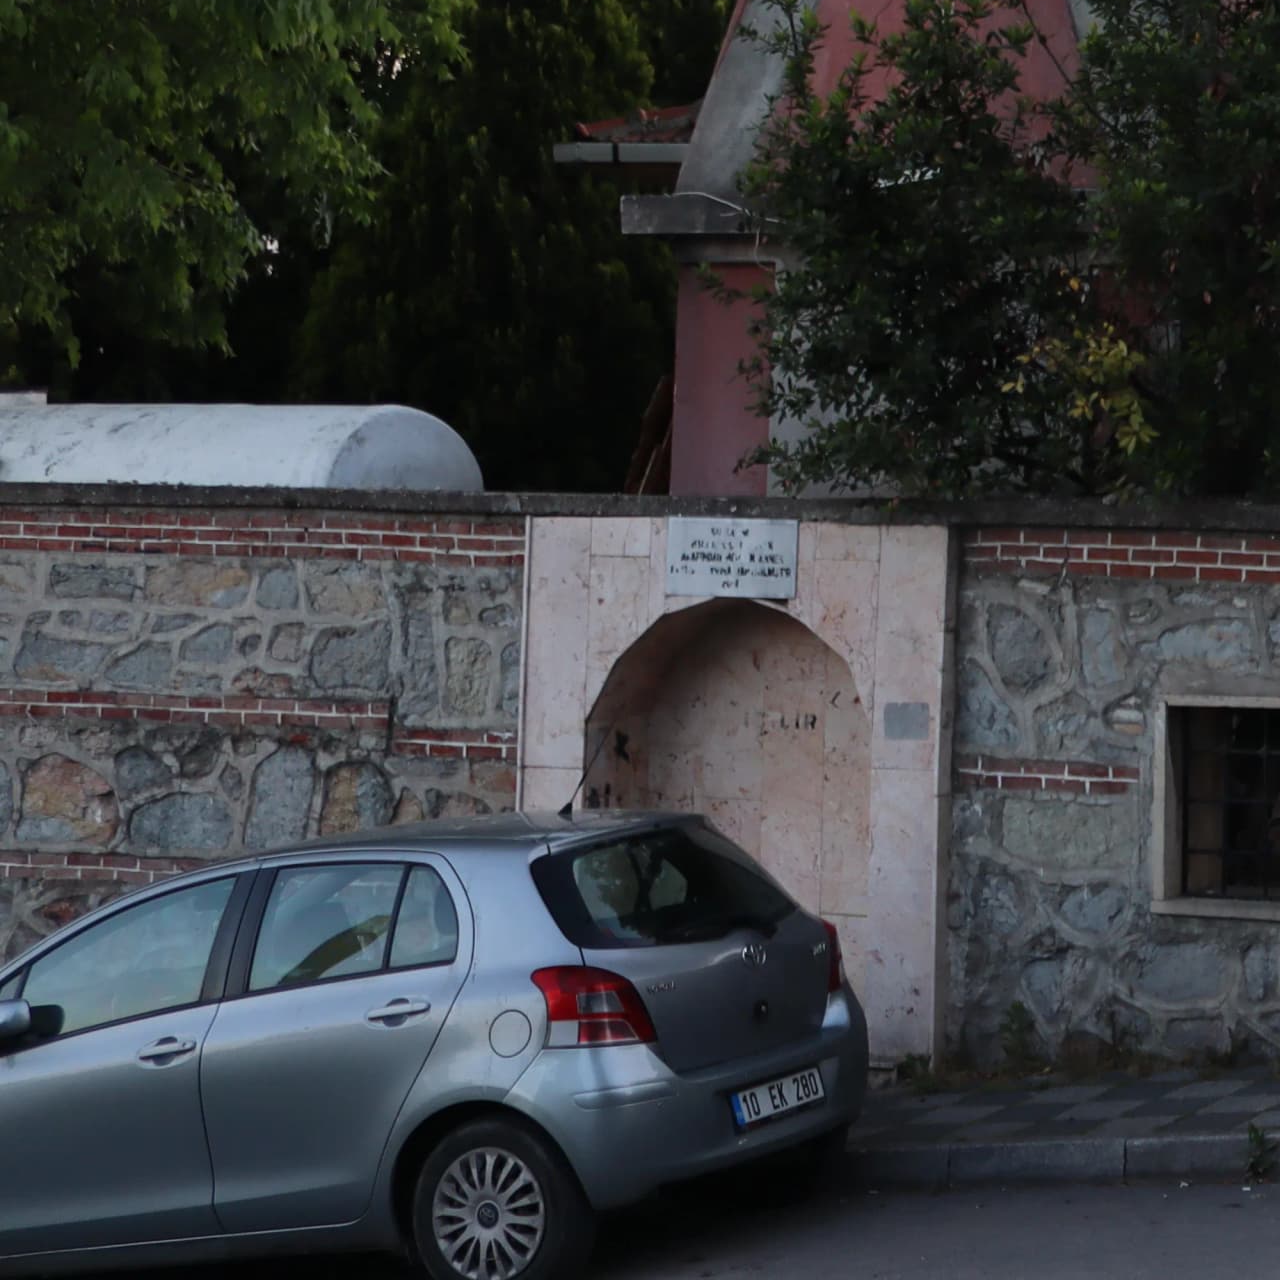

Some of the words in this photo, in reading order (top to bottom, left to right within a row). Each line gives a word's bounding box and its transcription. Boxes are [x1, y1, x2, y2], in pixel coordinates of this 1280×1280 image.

[742, 1091, 761, 1119] 10
[767, 1081, 789, 1111] EK
[792, 1071, 819, 1102] 280
